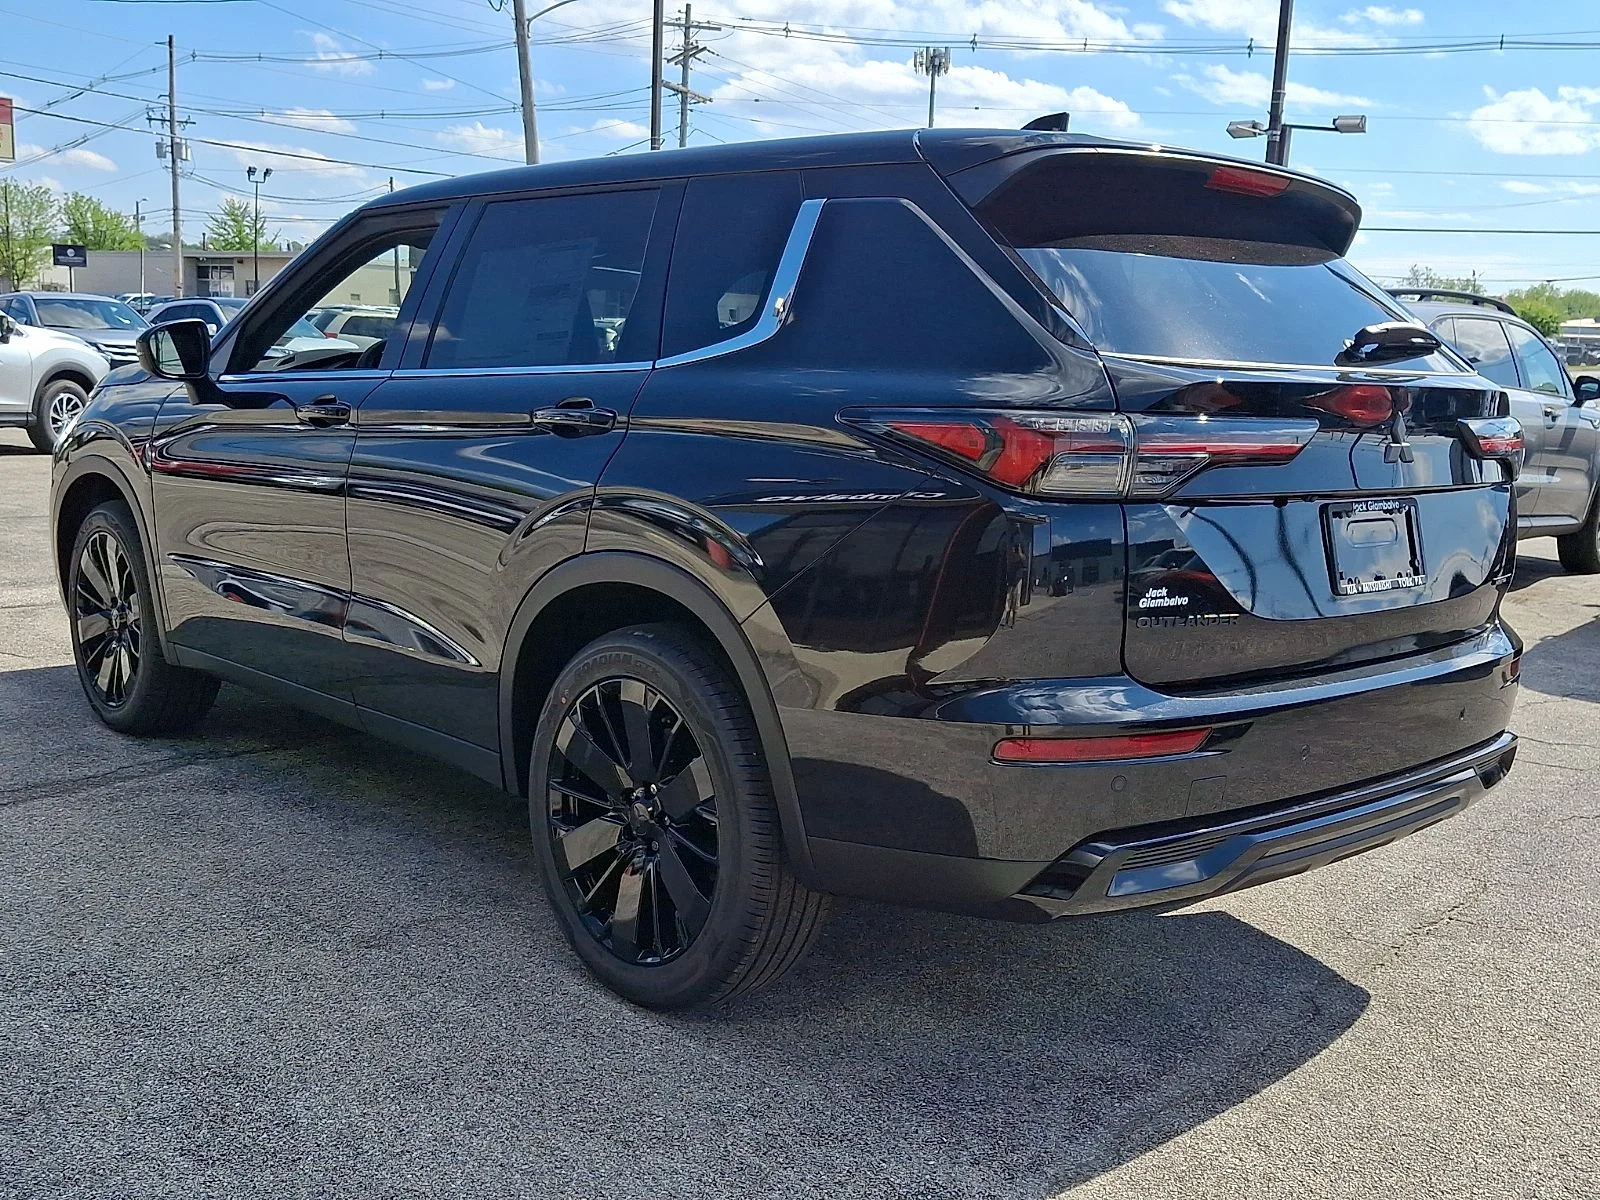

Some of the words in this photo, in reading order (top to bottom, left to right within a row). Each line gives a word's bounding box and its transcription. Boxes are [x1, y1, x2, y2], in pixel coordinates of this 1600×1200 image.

[1352, 502, 1366, 512] Jack
[1367, 501, 1400, 511] Giambalvo
[1146, 587, 1168, 598] Jack
[1346, 585, 1358, 595] KIA
[1139, 596, 1188, 608] Giambalvo
[1136, 613, 1240, 629] OUTLANDER
